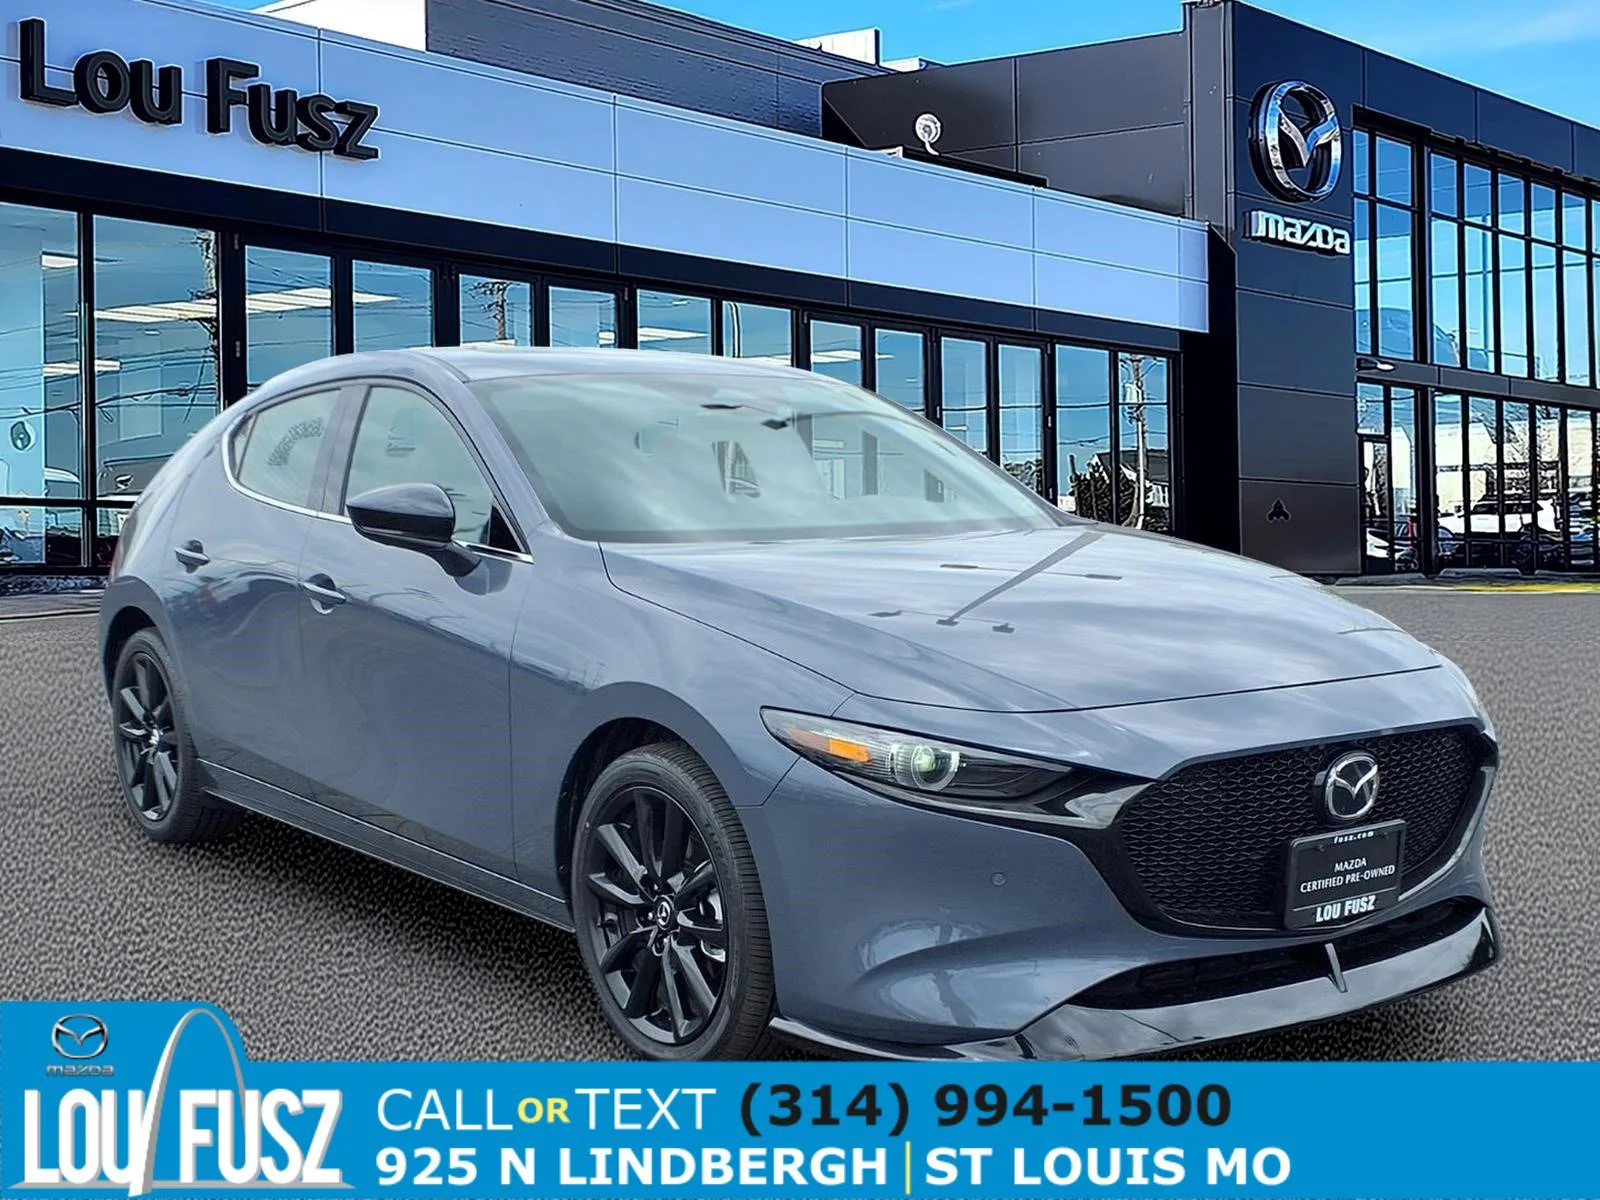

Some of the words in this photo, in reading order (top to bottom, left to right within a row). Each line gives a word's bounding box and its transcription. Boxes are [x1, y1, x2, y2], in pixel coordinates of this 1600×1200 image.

[19, 18, 182, 126] Lou
[206, 57, 379, 160] Fusz
[1250, 210, 1351, 255] mazda
[1333, 831, 1374, 844] fusz.com
[1334, 857, 1367, 873] MAZDA
[1300, 876, 1343, 893] CERTIFIED
[1345, 865, 1396, 884] PRE-OWNED
[1315, 902, 1341, 922] LOU
[1344, 895, 1377, 916] FUSZ
